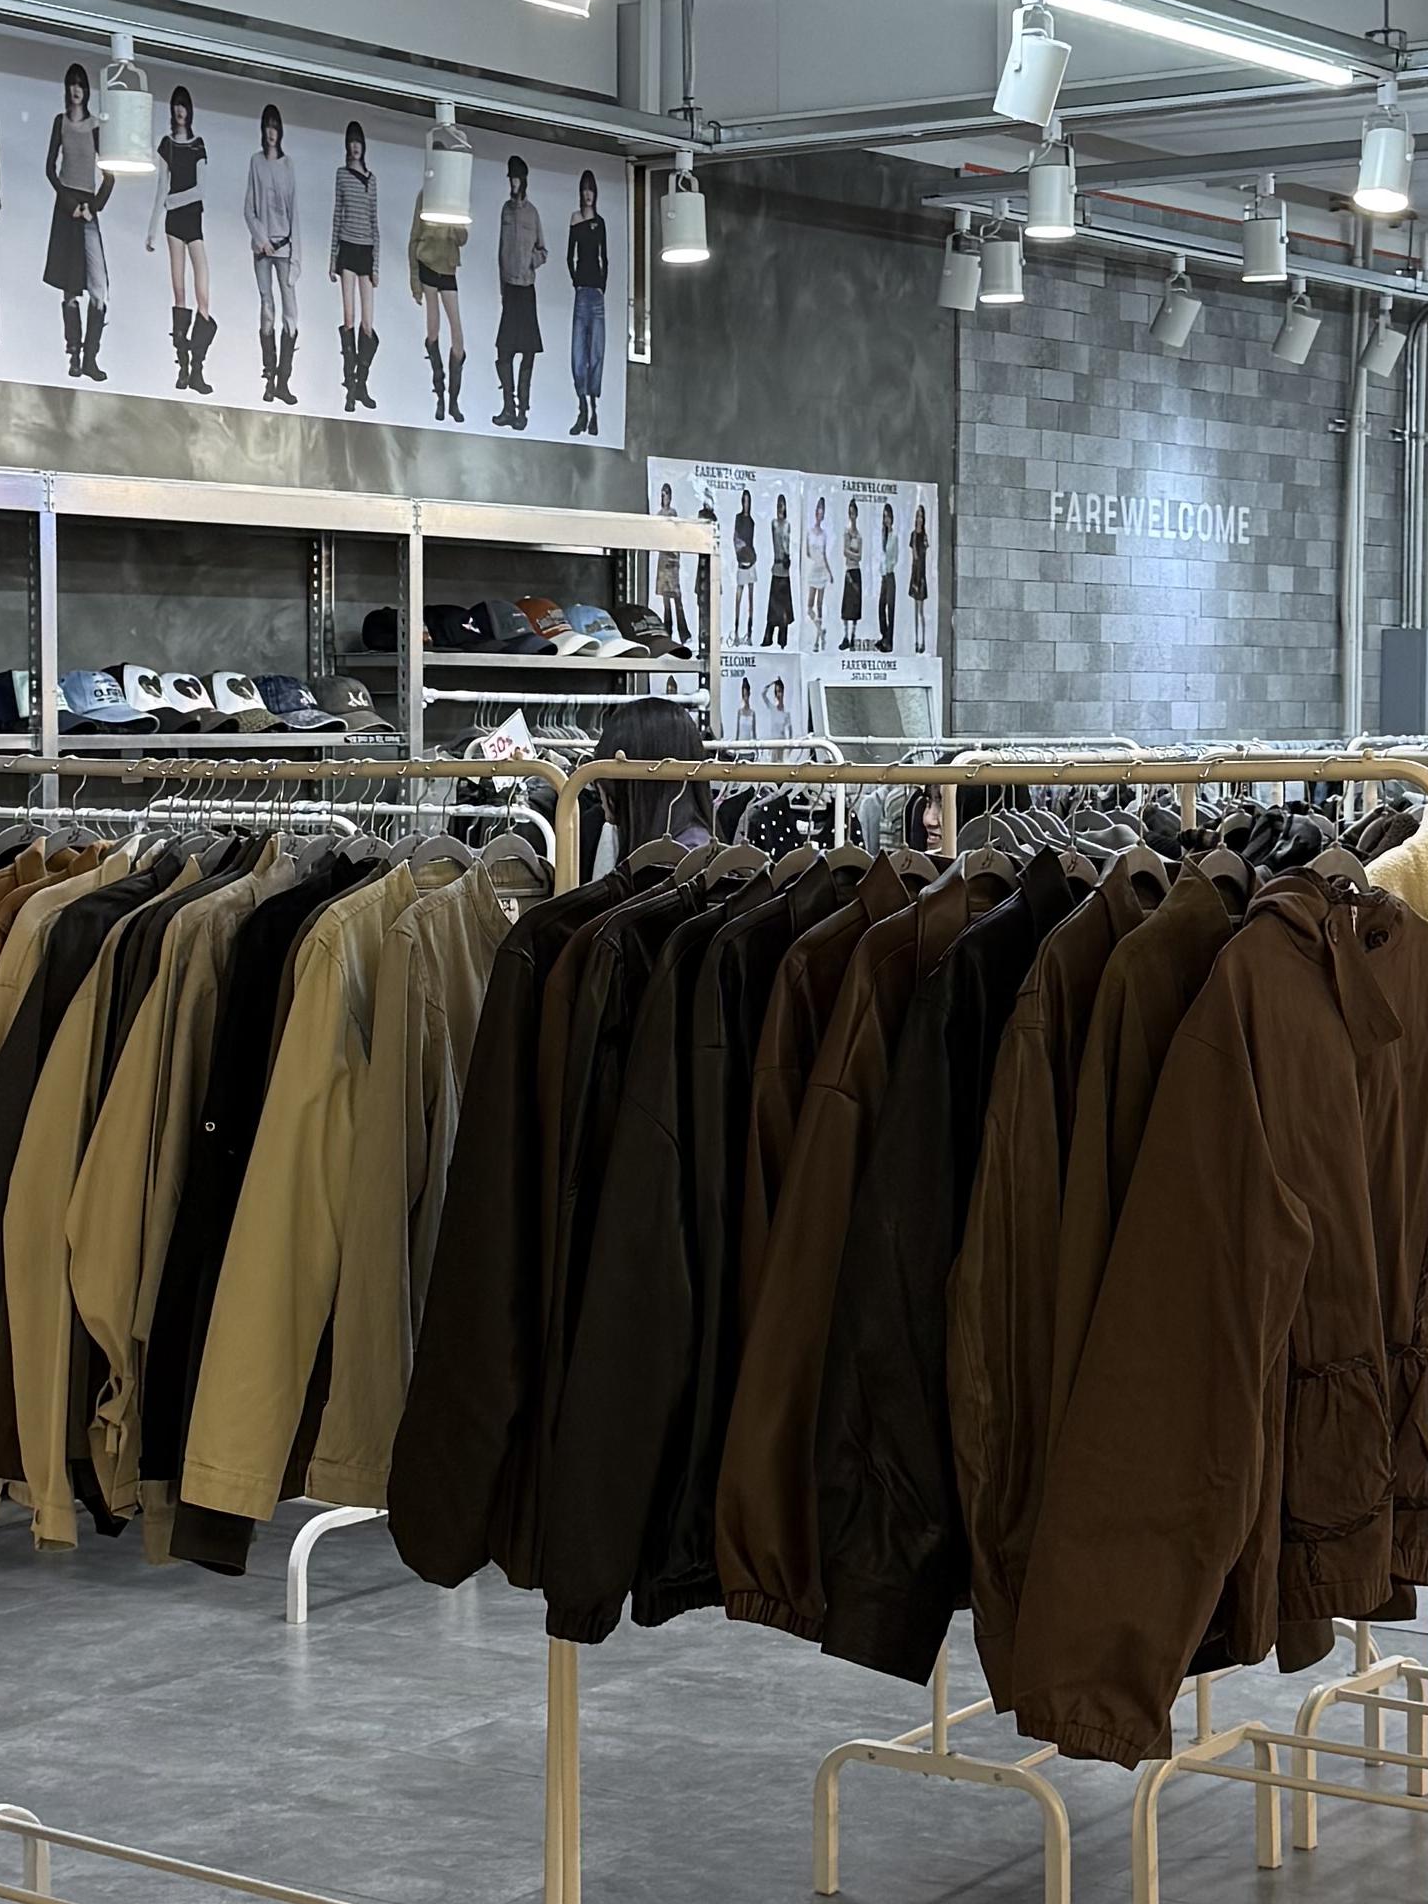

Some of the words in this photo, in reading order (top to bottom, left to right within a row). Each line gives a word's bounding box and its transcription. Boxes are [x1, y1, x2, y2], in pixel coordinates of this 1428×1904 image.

[1050, 490, 1250, 544] FAREWELCOME
[719, 656, 757, 667] ELCOME
[842, 659, 898, 671] FAREWELCOME
